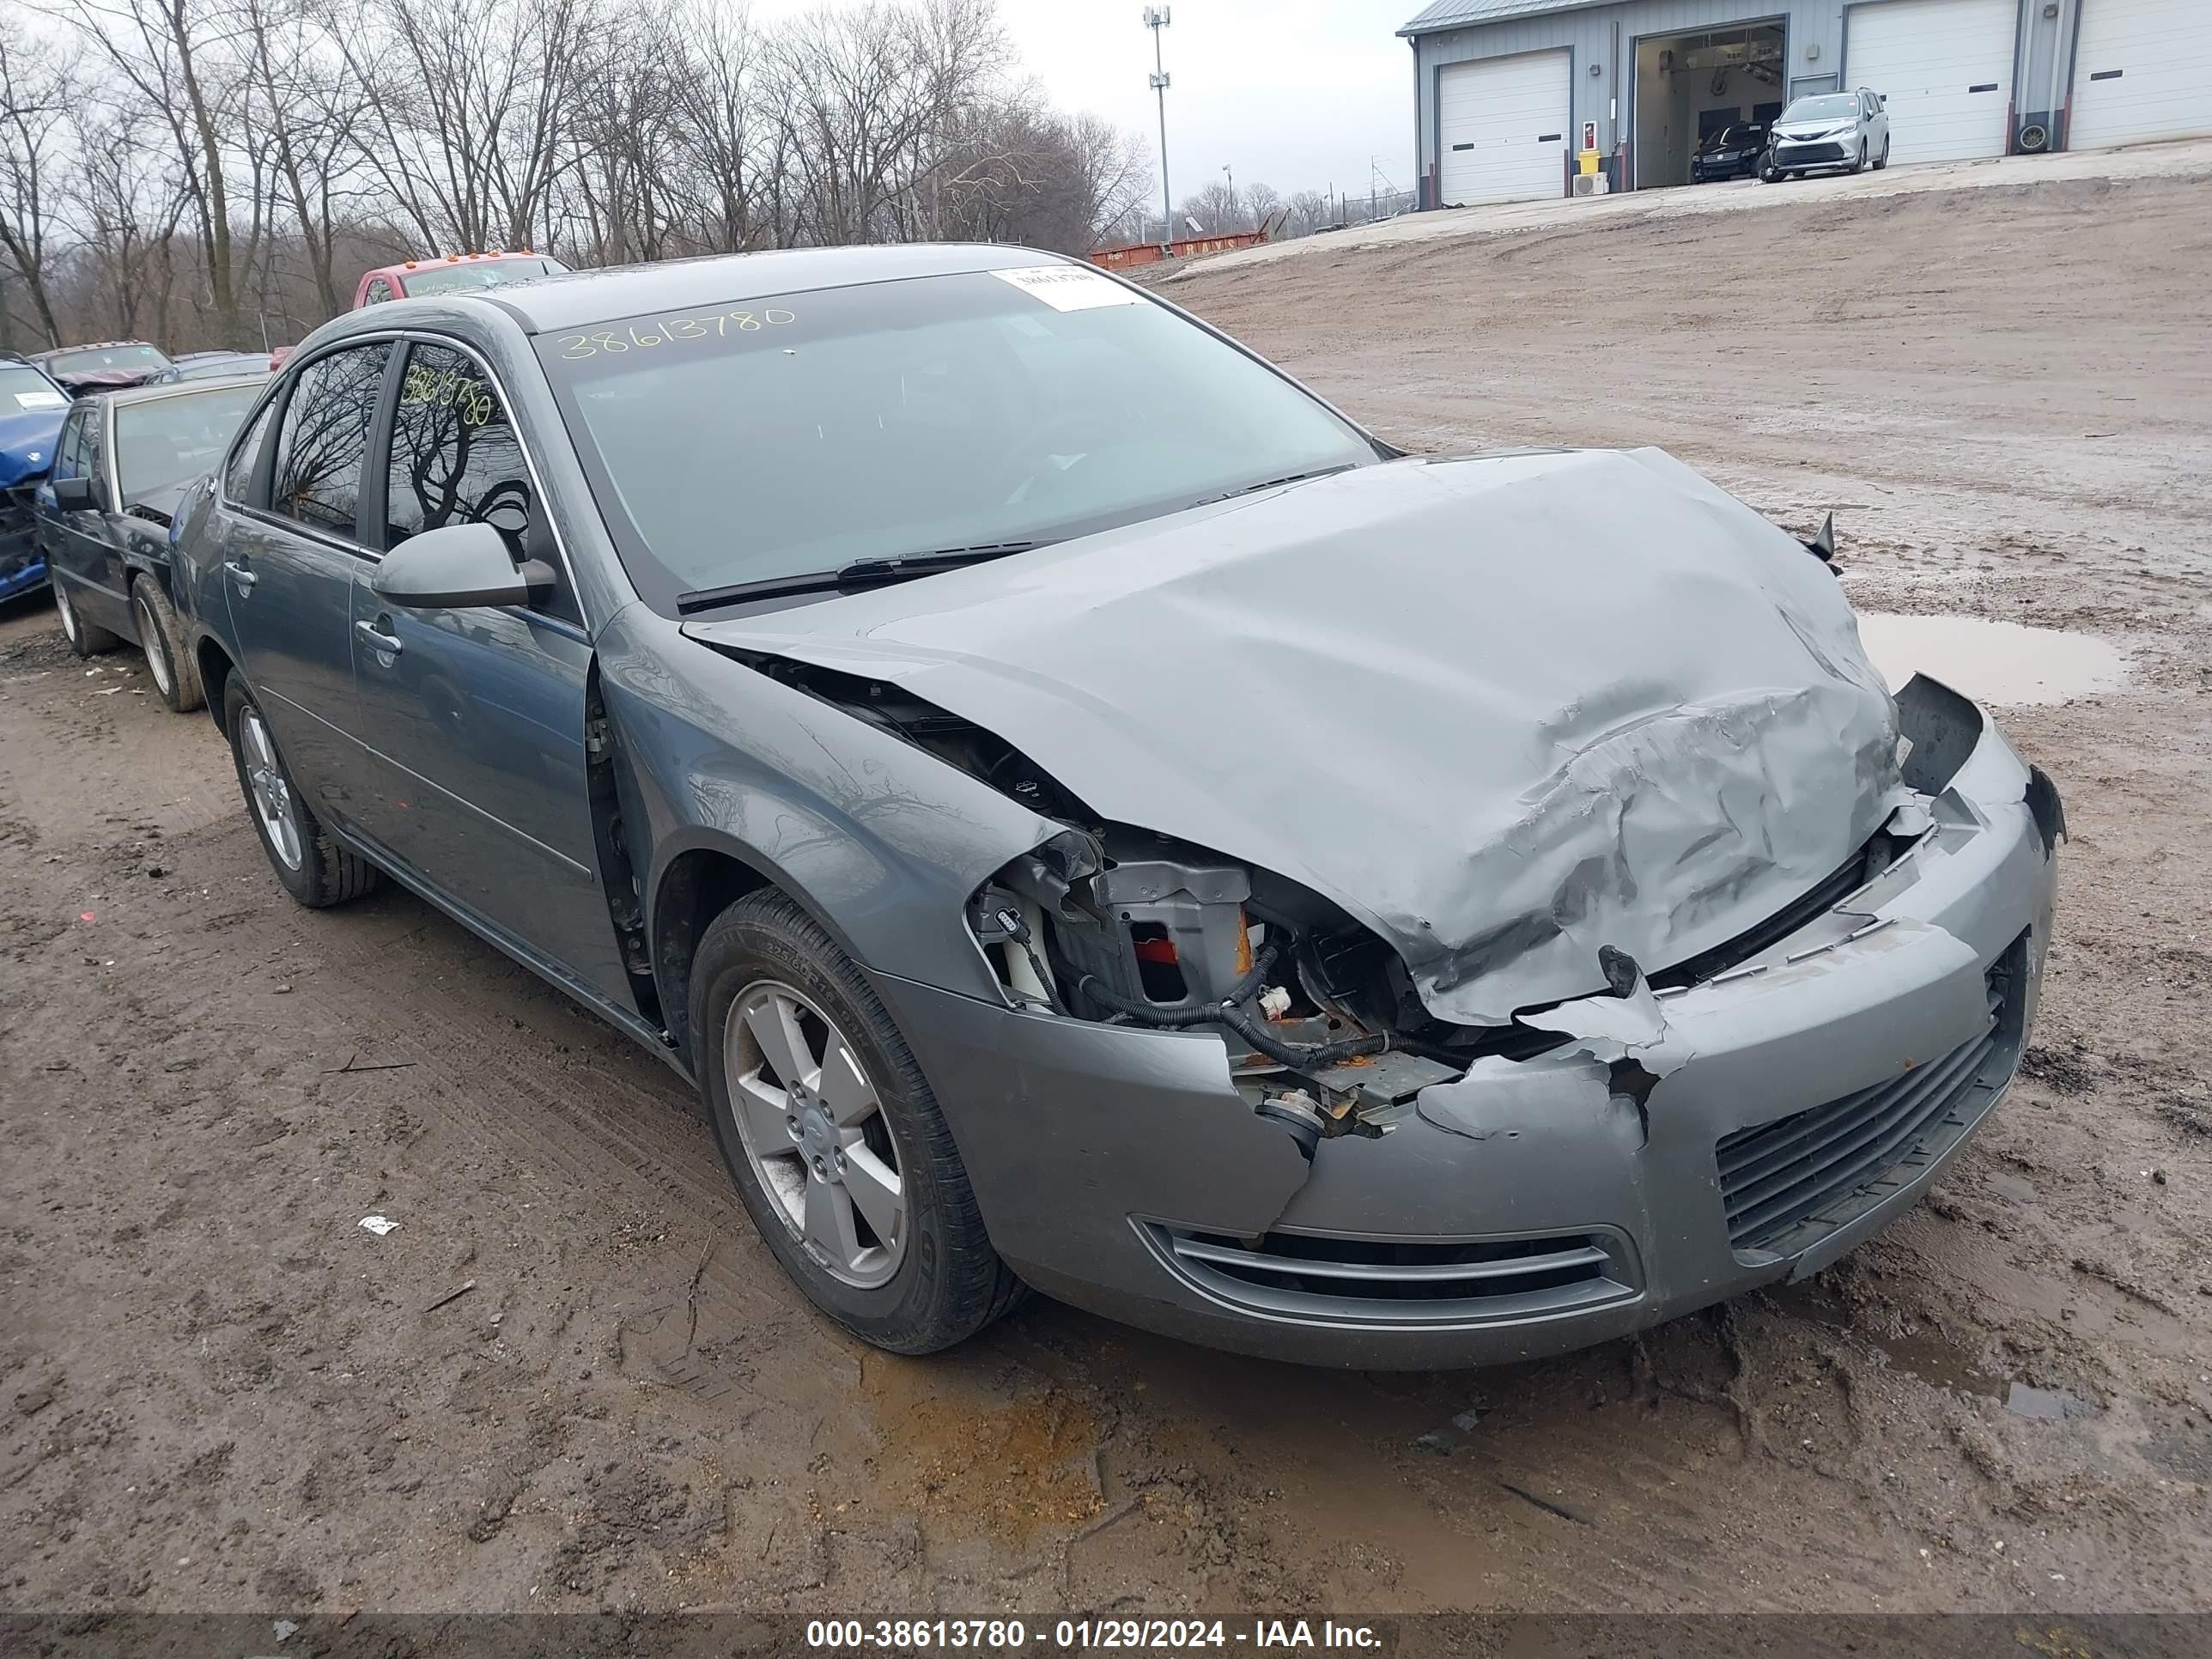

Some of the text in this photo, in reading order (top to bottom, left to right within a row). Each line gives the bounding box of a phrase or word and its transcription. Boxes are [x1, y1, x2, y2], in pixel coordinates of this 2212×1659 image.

[1186, 239, 1235, 256] RAYS
[558, 309, 795, 359] 38613780
[401, 364, 491, 426] 38613780
